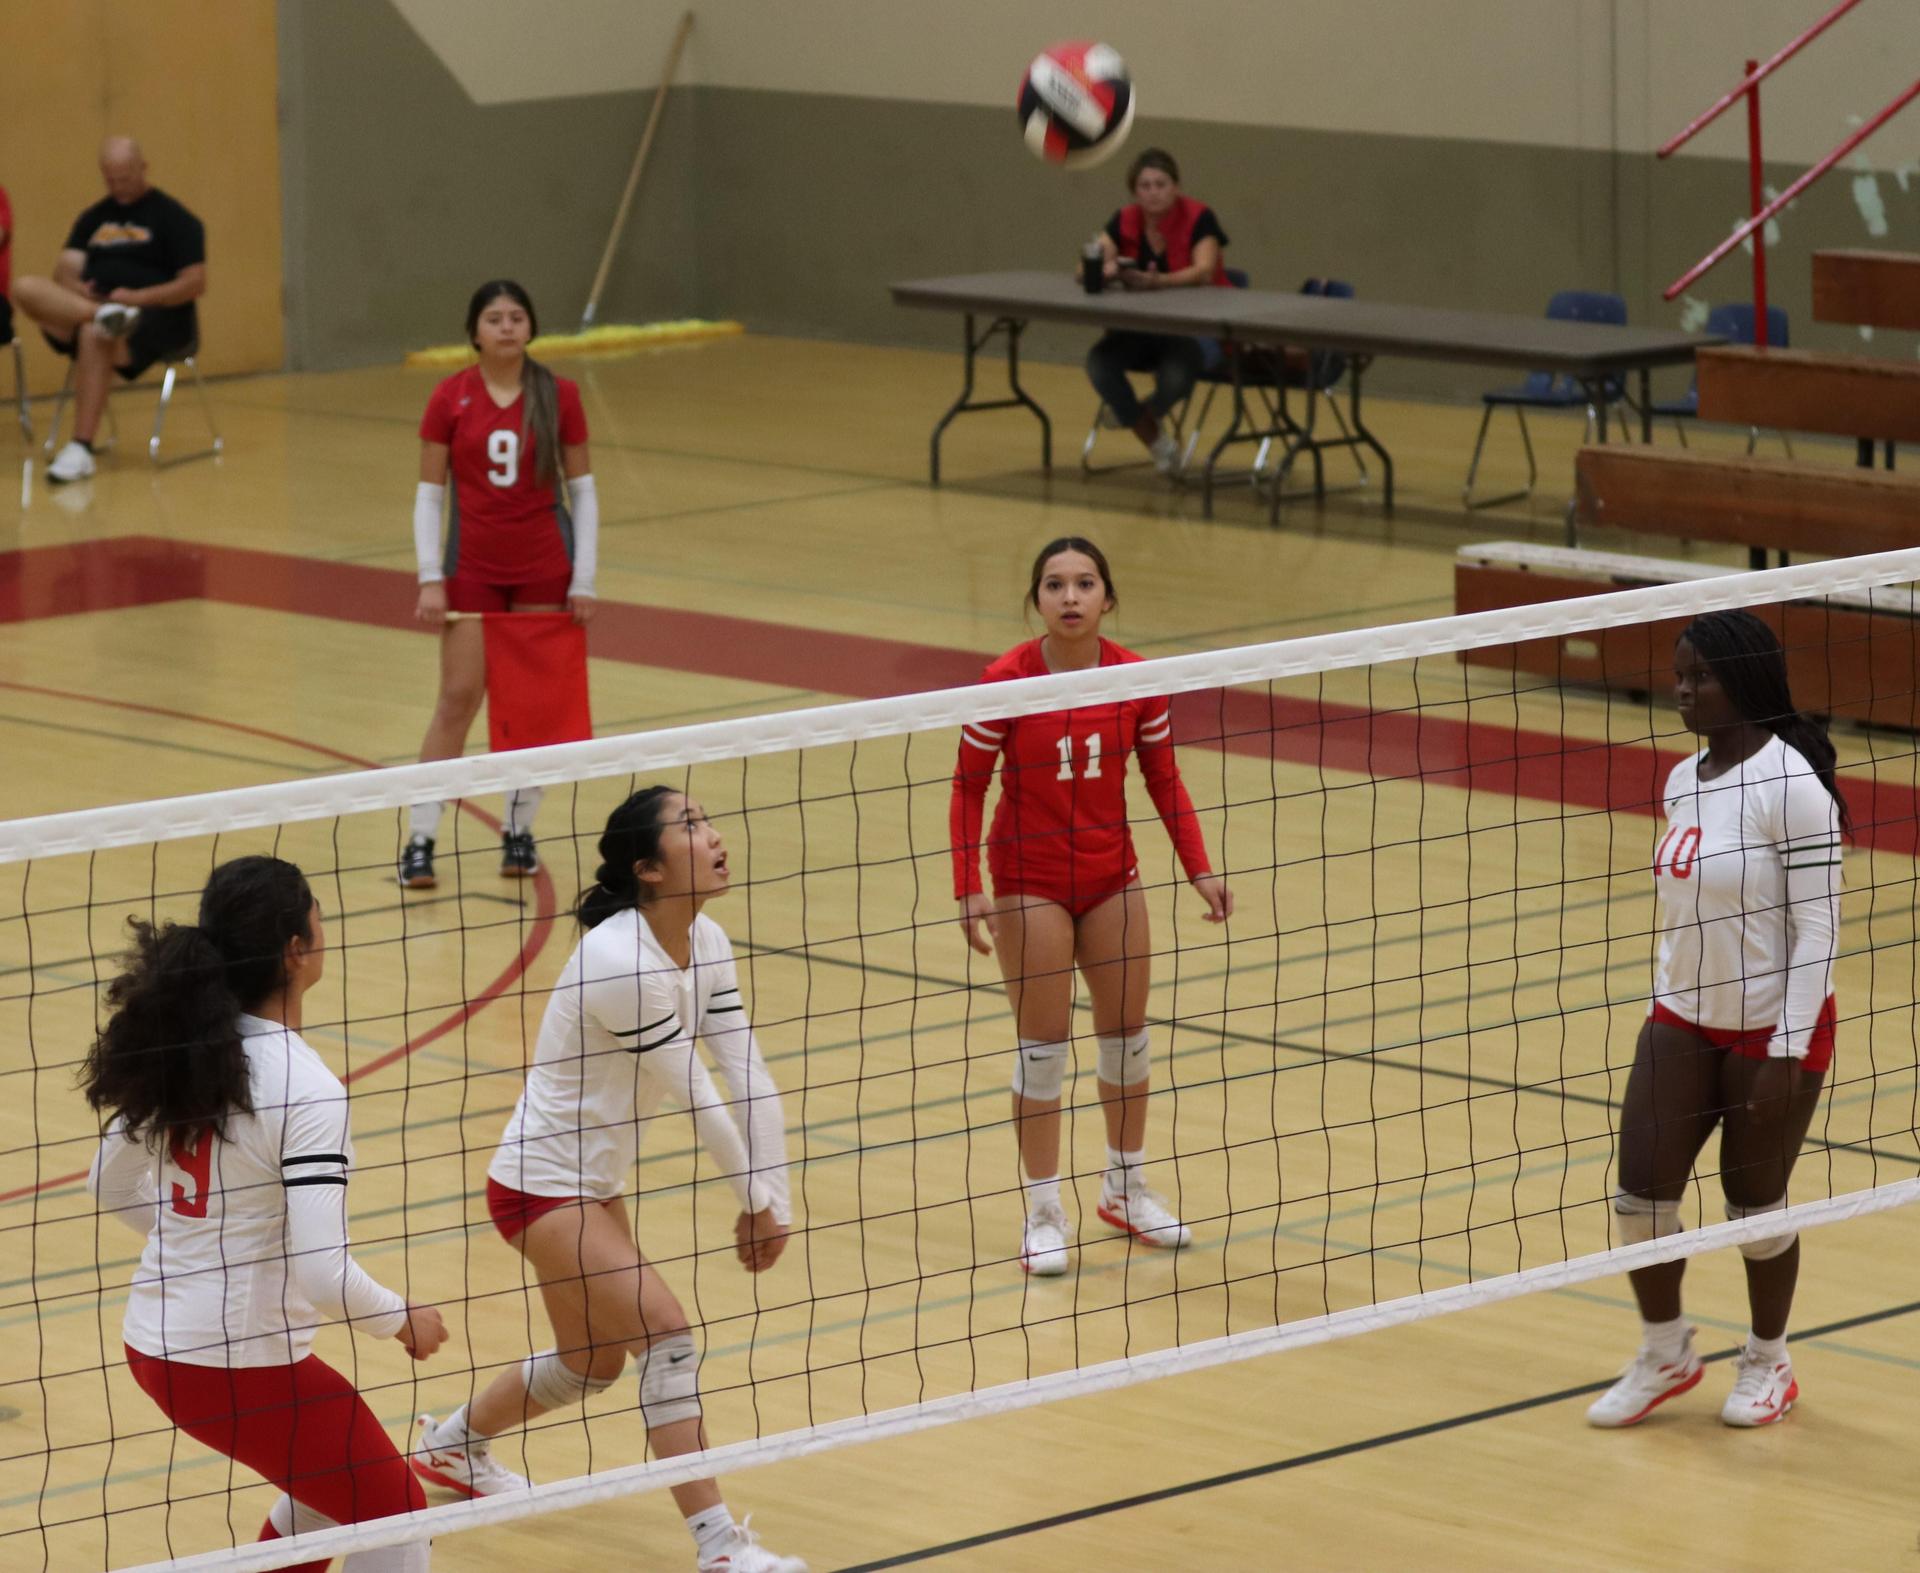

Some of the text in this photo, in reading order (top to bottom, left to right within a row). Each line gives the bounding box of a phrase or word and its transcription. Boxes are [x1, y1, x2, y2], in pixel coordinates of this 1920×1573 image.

[487, 428, 518, 487] 9
[1056, 732, 1102, 780] 11
[1654, 826, 1703, 879] 10
